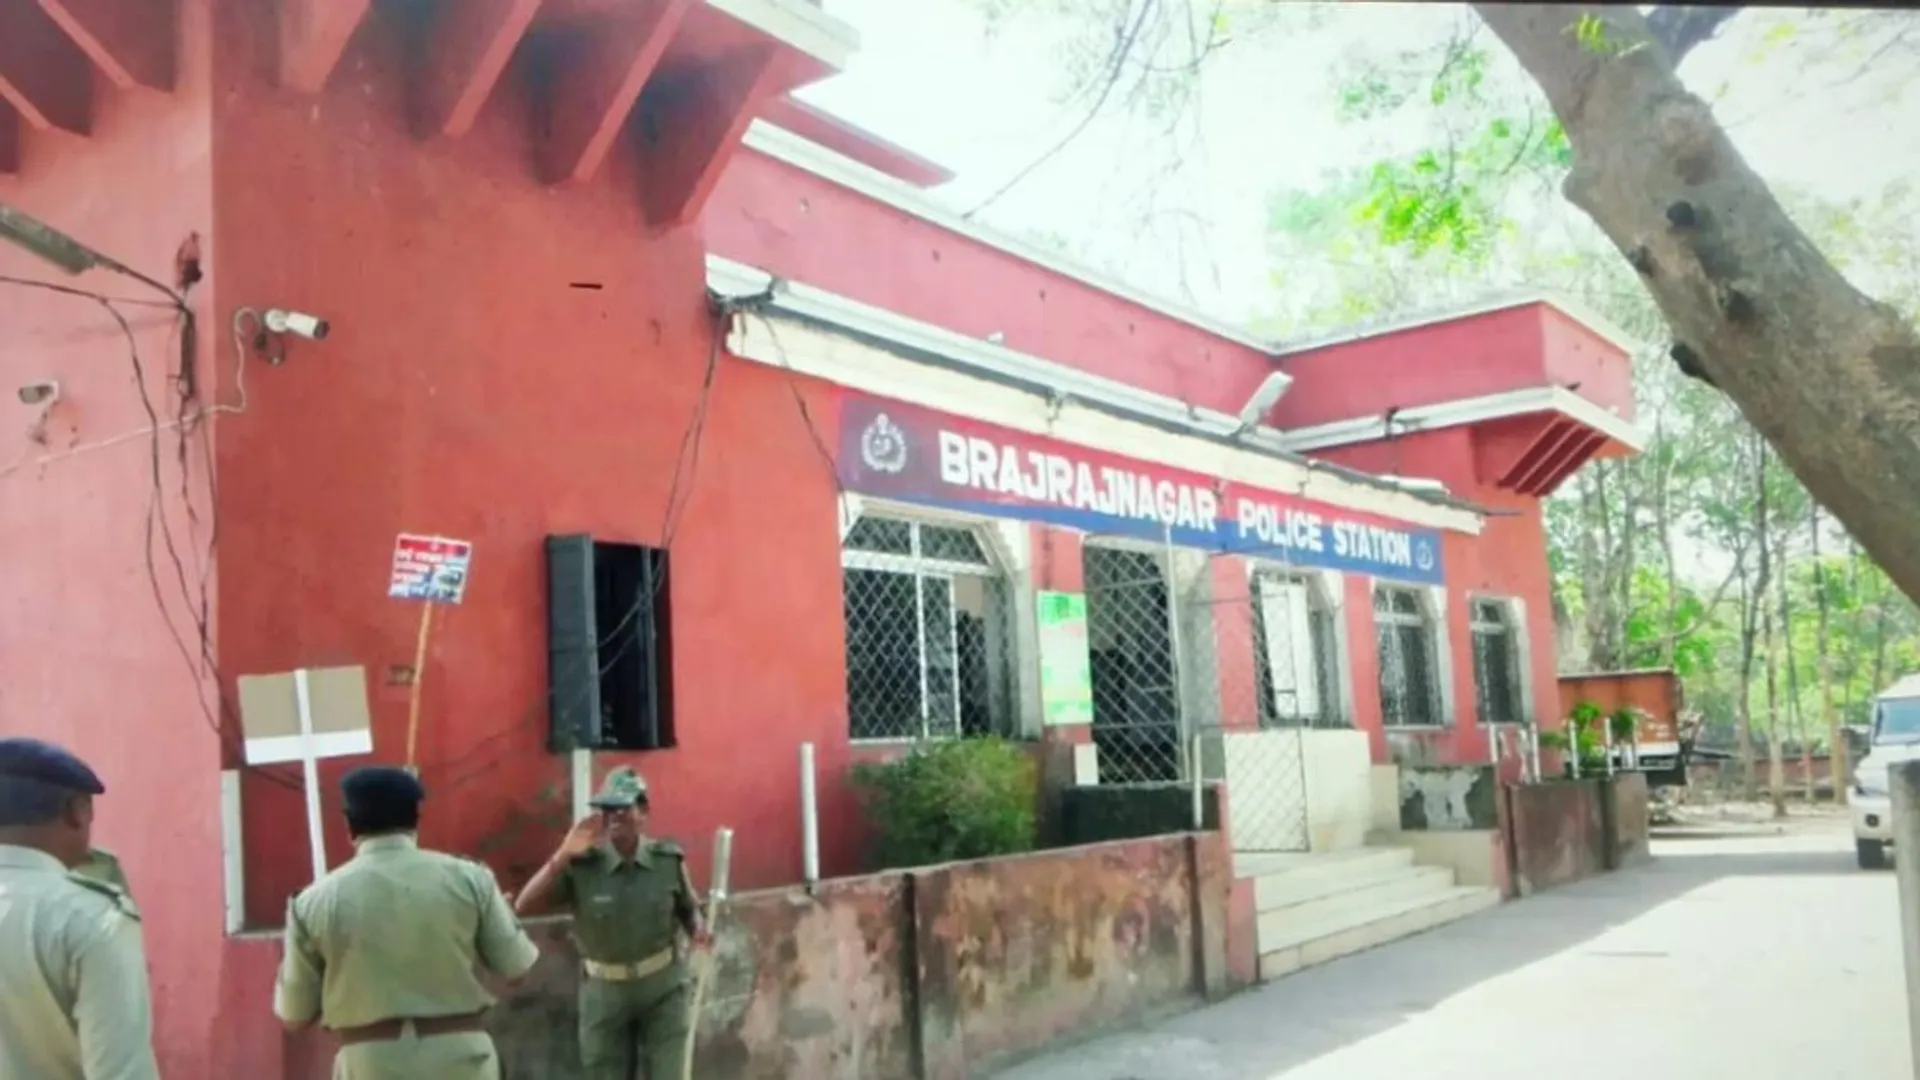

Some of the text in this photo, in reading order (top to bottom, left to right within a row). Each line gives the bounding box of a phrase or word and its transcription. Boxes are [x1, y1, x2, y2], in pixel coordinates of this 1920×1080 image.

[938, 430, 1412, 568] BRAJRAJNAGAR POLICE STATION
